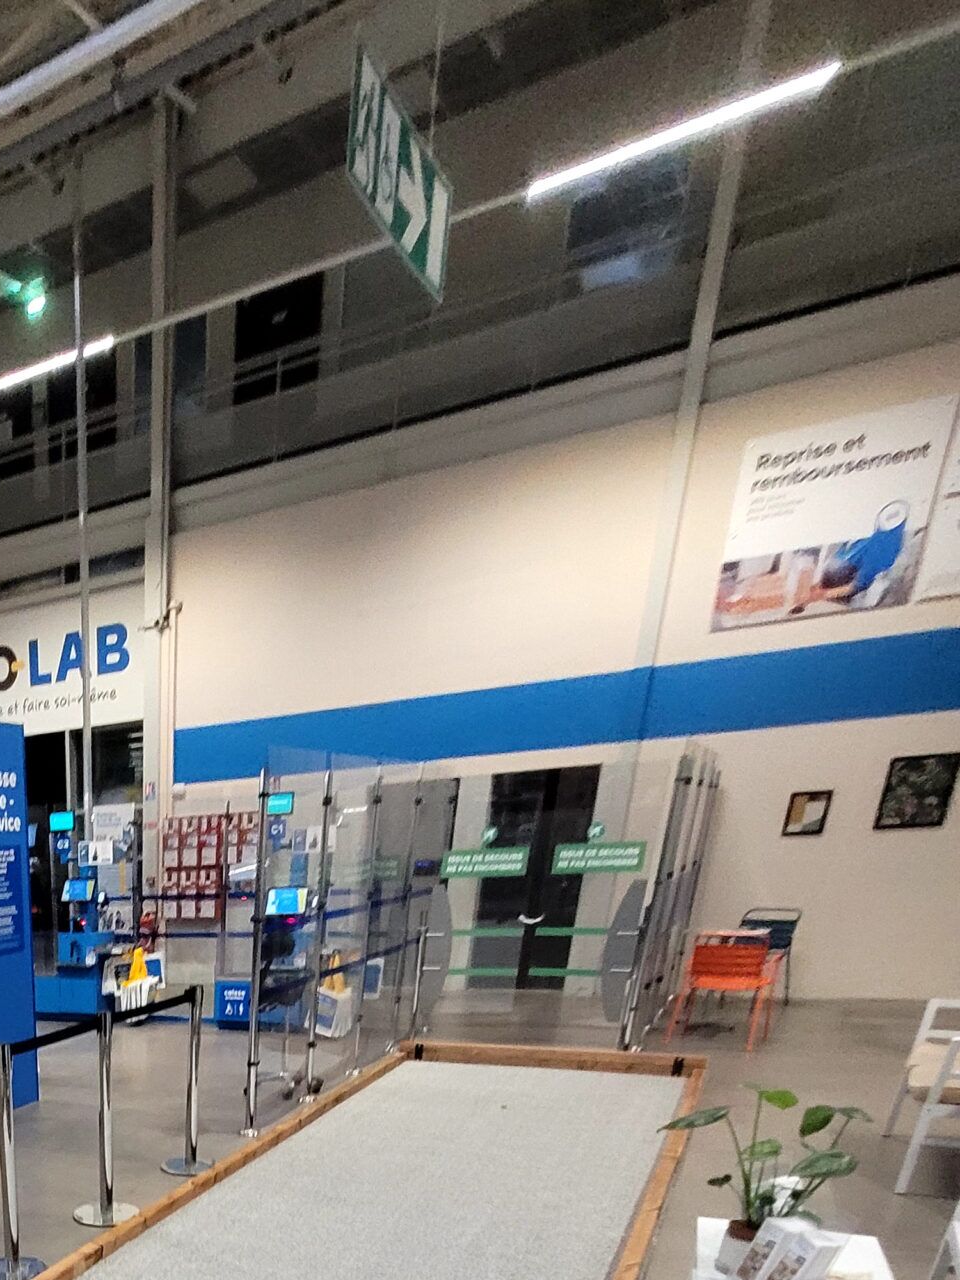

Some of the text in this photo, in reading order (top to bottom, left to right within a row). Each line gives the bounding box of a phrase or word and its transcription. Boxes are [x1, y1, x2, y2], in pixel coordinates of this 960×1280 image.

[751, 441, 932, 493] remboursement
[755, 432, 867, 472] Reprise et
[7, 699, 18, 717] et
[23, 696, 50, 717] faire
